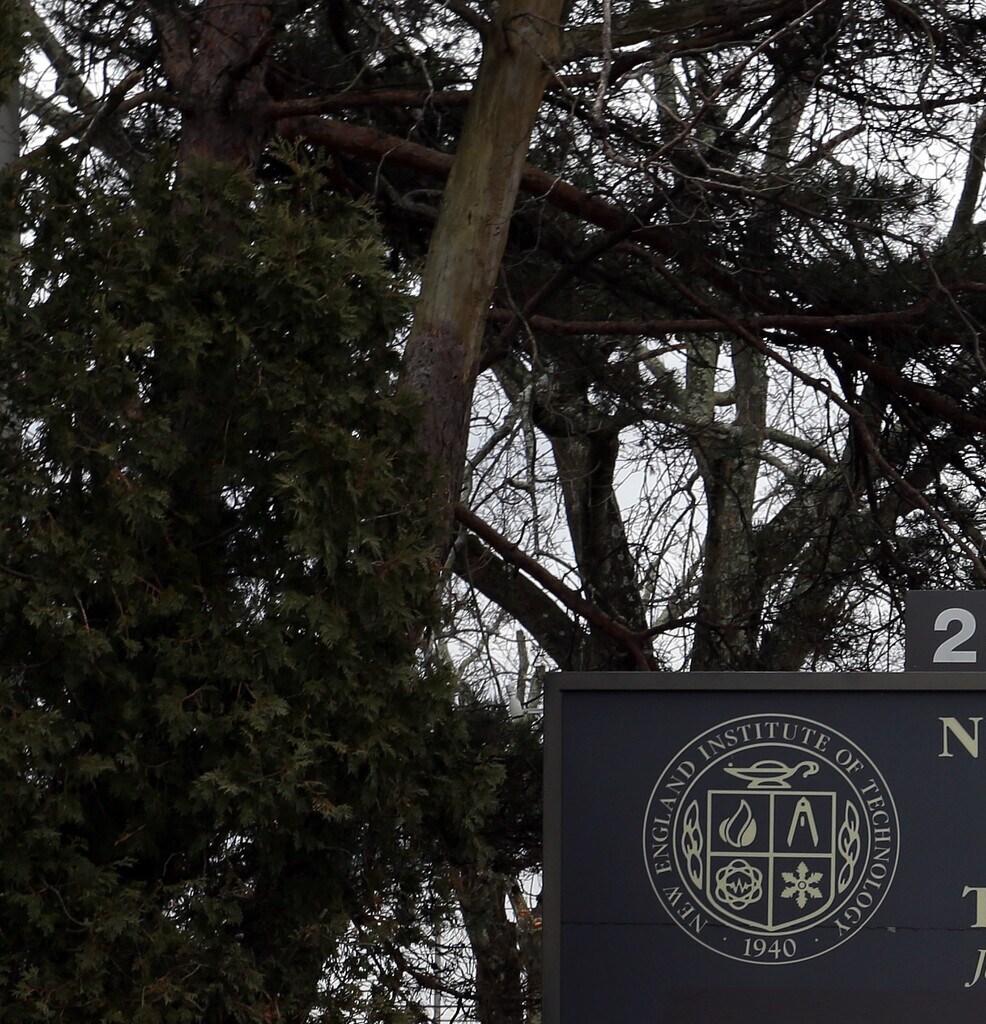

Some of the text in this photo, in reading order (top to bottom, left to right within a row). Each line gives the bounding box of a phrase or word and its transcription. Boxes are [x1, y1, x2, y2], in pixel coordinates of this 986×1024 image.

[651, 721, 891, 937] NEW ENGLAND INSTITUTE OF TECHNOLOGY
[742, 938, 797, 959] 1940
